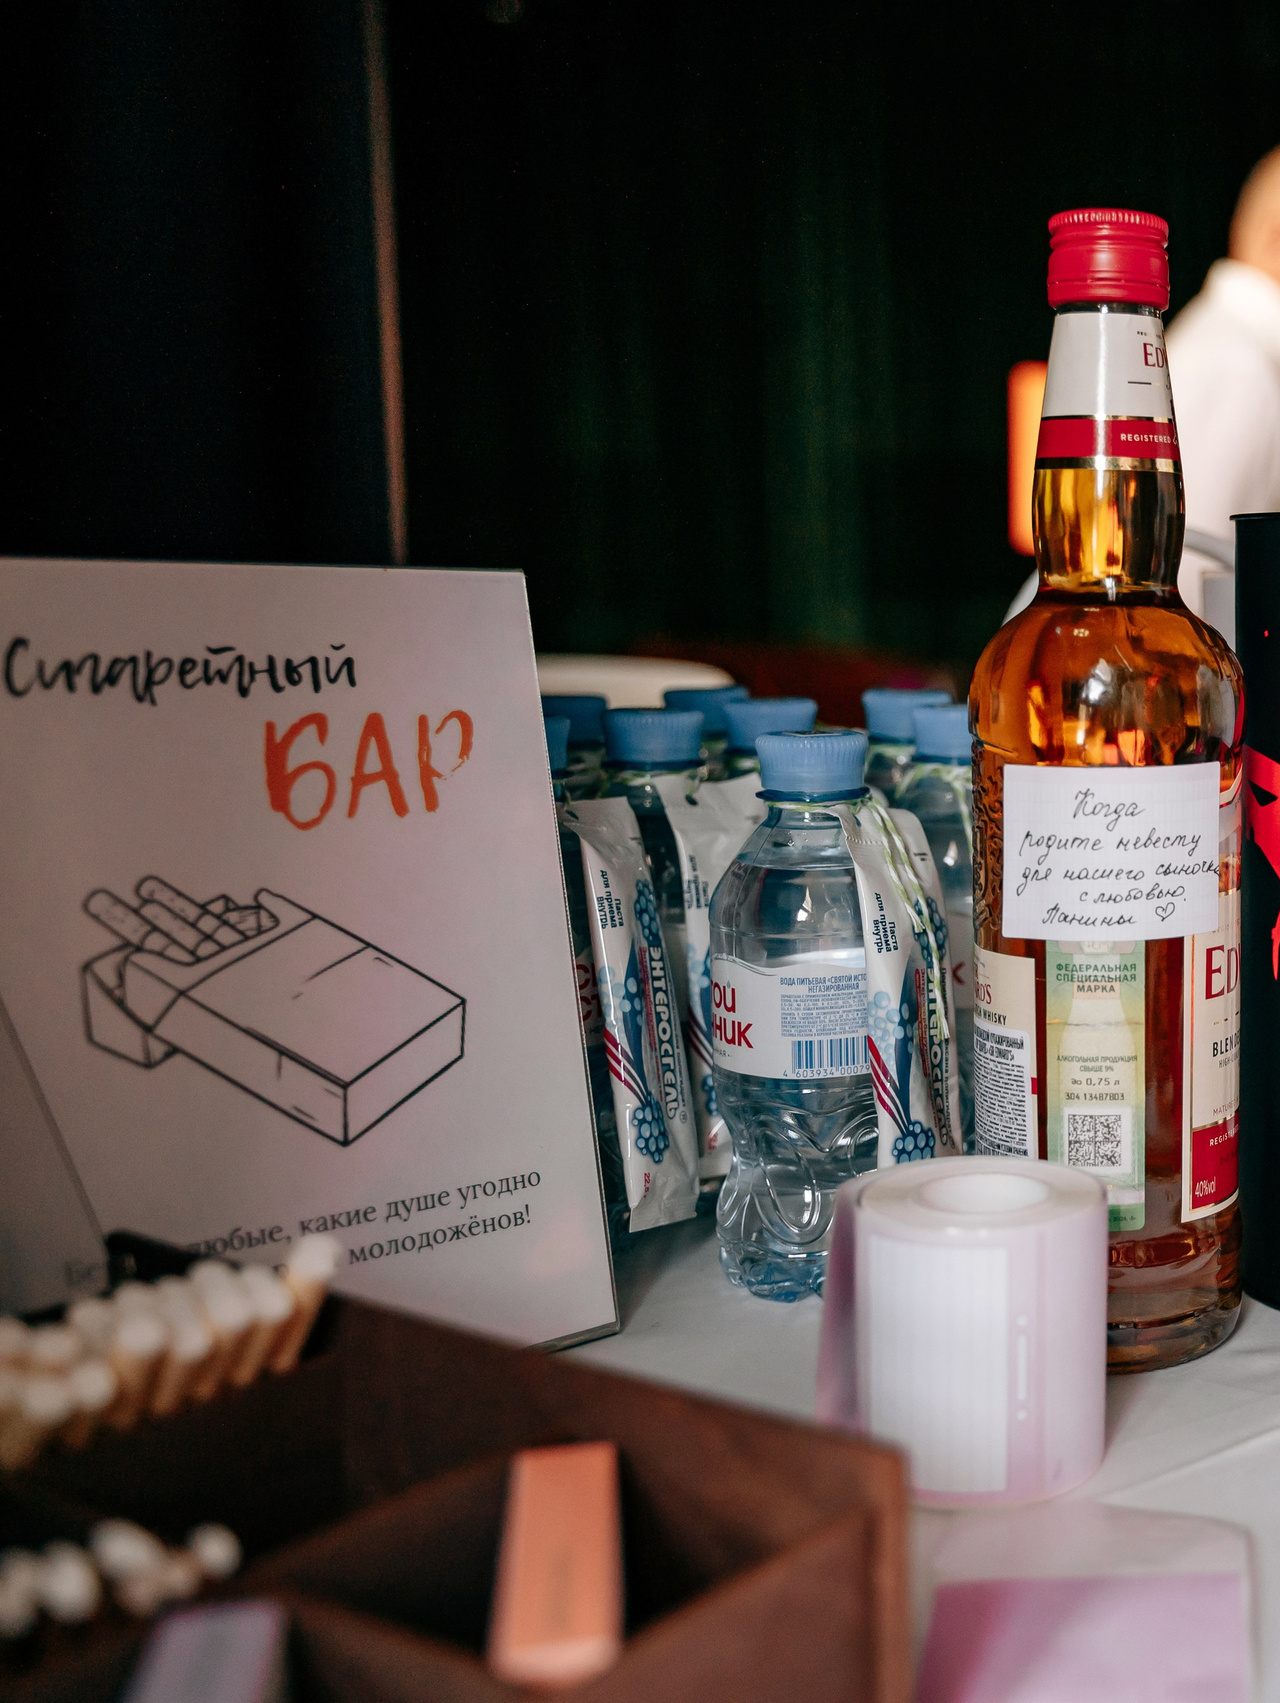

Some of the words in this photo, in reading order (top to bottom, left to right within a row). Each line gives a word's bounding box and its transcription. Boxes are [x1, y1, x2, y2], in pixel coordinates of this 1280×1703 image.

[1143, 342, 1168, 369] ED
[1120, 432, 1172, 445] REGISTERED
[4, 636, 358, 706] Сигаретный
[264, 709, 474, 831] БАР
[1073, 788, 1147, 831] Когда
[1019, 830, 1105, 865] родите
[1116, 828, 1202, 857] невесту
[599, 869, 611, 889] для
[1063, 867, 1146, 882] нашего
[604, 890, 618, 929] приема
[874, 892, 885, 911] для
[614, 898, 625, 927] Паста
[872, 919, 884, 954] внутрь
[879, 914, 892, 953] приема
[888, 921, 899, 951] Паста
[1056, 963, 1137, 974] ФЕДЕРАЛЬНАЯ
[1056, 973, 1137, 983] СПЕЦИАЛЬНАЯ
[1205, 942, 1241, 999] ED
[780, 976, 796, 986] ВОДА
[796, 976, 827, 986] ПИТЬЕВАЯ
[808, 982, 860, 993] НЕГАЗИРОВАННАЯ
[1076, 984, 1116, 993] МАРКА
[983, 1008, 1007, 1026] WHISKY
[650, 946, 680, 1120] ЭНТЕРОСГЕЛЬ
[1056, 1055, 1100, 1063] АЛКОГОЛЬНАЯ
[1100, 1054, 1138, 1063] ПРОДУКЦИЯ
[1104, 1064, 1114, 1072] 9%
[795, 1068, 835, 1078] 603934
[1086, 1077, 1111, 1087] 0,75
[1065, 1092, 1081, 1101] 304
[299, 1204, 378, 1238] какие
[385, 1188, 452, 1221] душе
[457, 1169, 543, 1210] угодно
[349, 1203, 533, 1265] молодожёнов!
